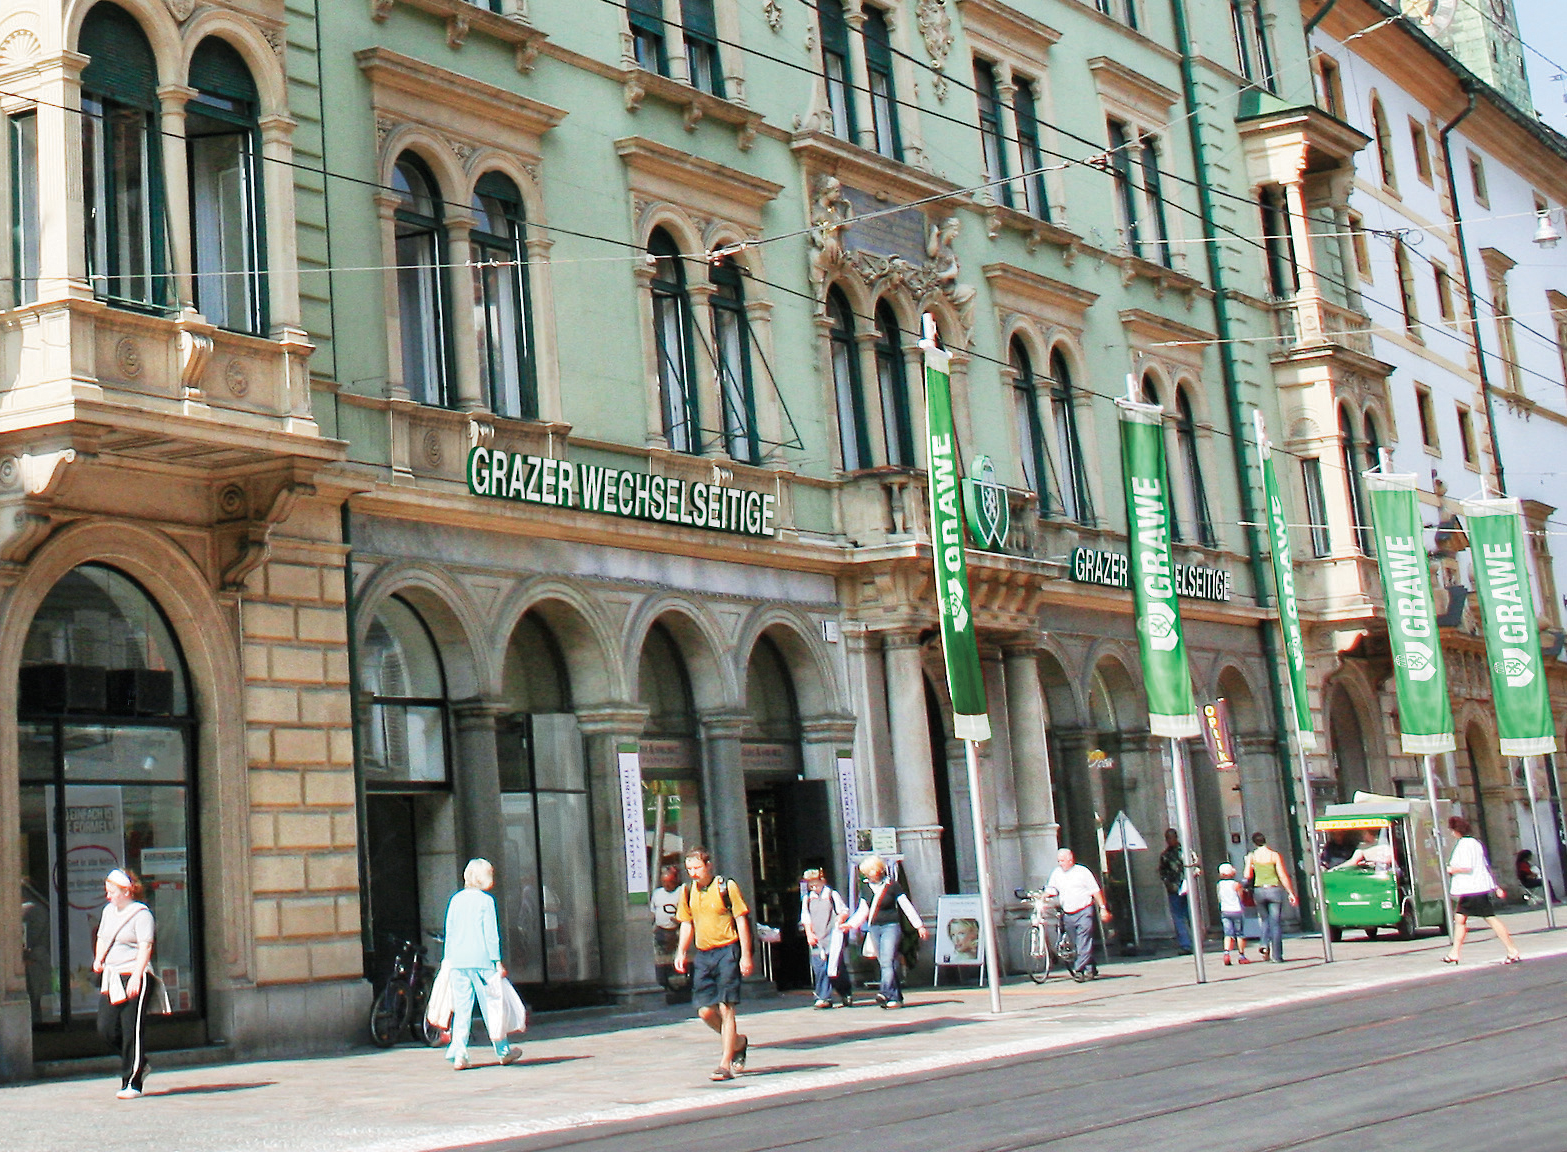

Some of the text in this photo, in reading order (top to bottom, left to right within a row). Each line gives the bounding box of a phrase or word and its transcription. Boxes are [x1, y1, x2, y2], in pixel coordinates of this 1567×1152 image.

[469, 446, 776, 537] GRAZER WECHSELSEITIGE
[1131, 476, 1174, 600] GRAWE
[1074, 546, 1232, 602] GRAZER ELSEITIGE
[1384, 535, 1432, 638] GRAWE
[1482, 542, 1530, 645] GRAWE
[1203, 704, 1230, 763] OPTIK
